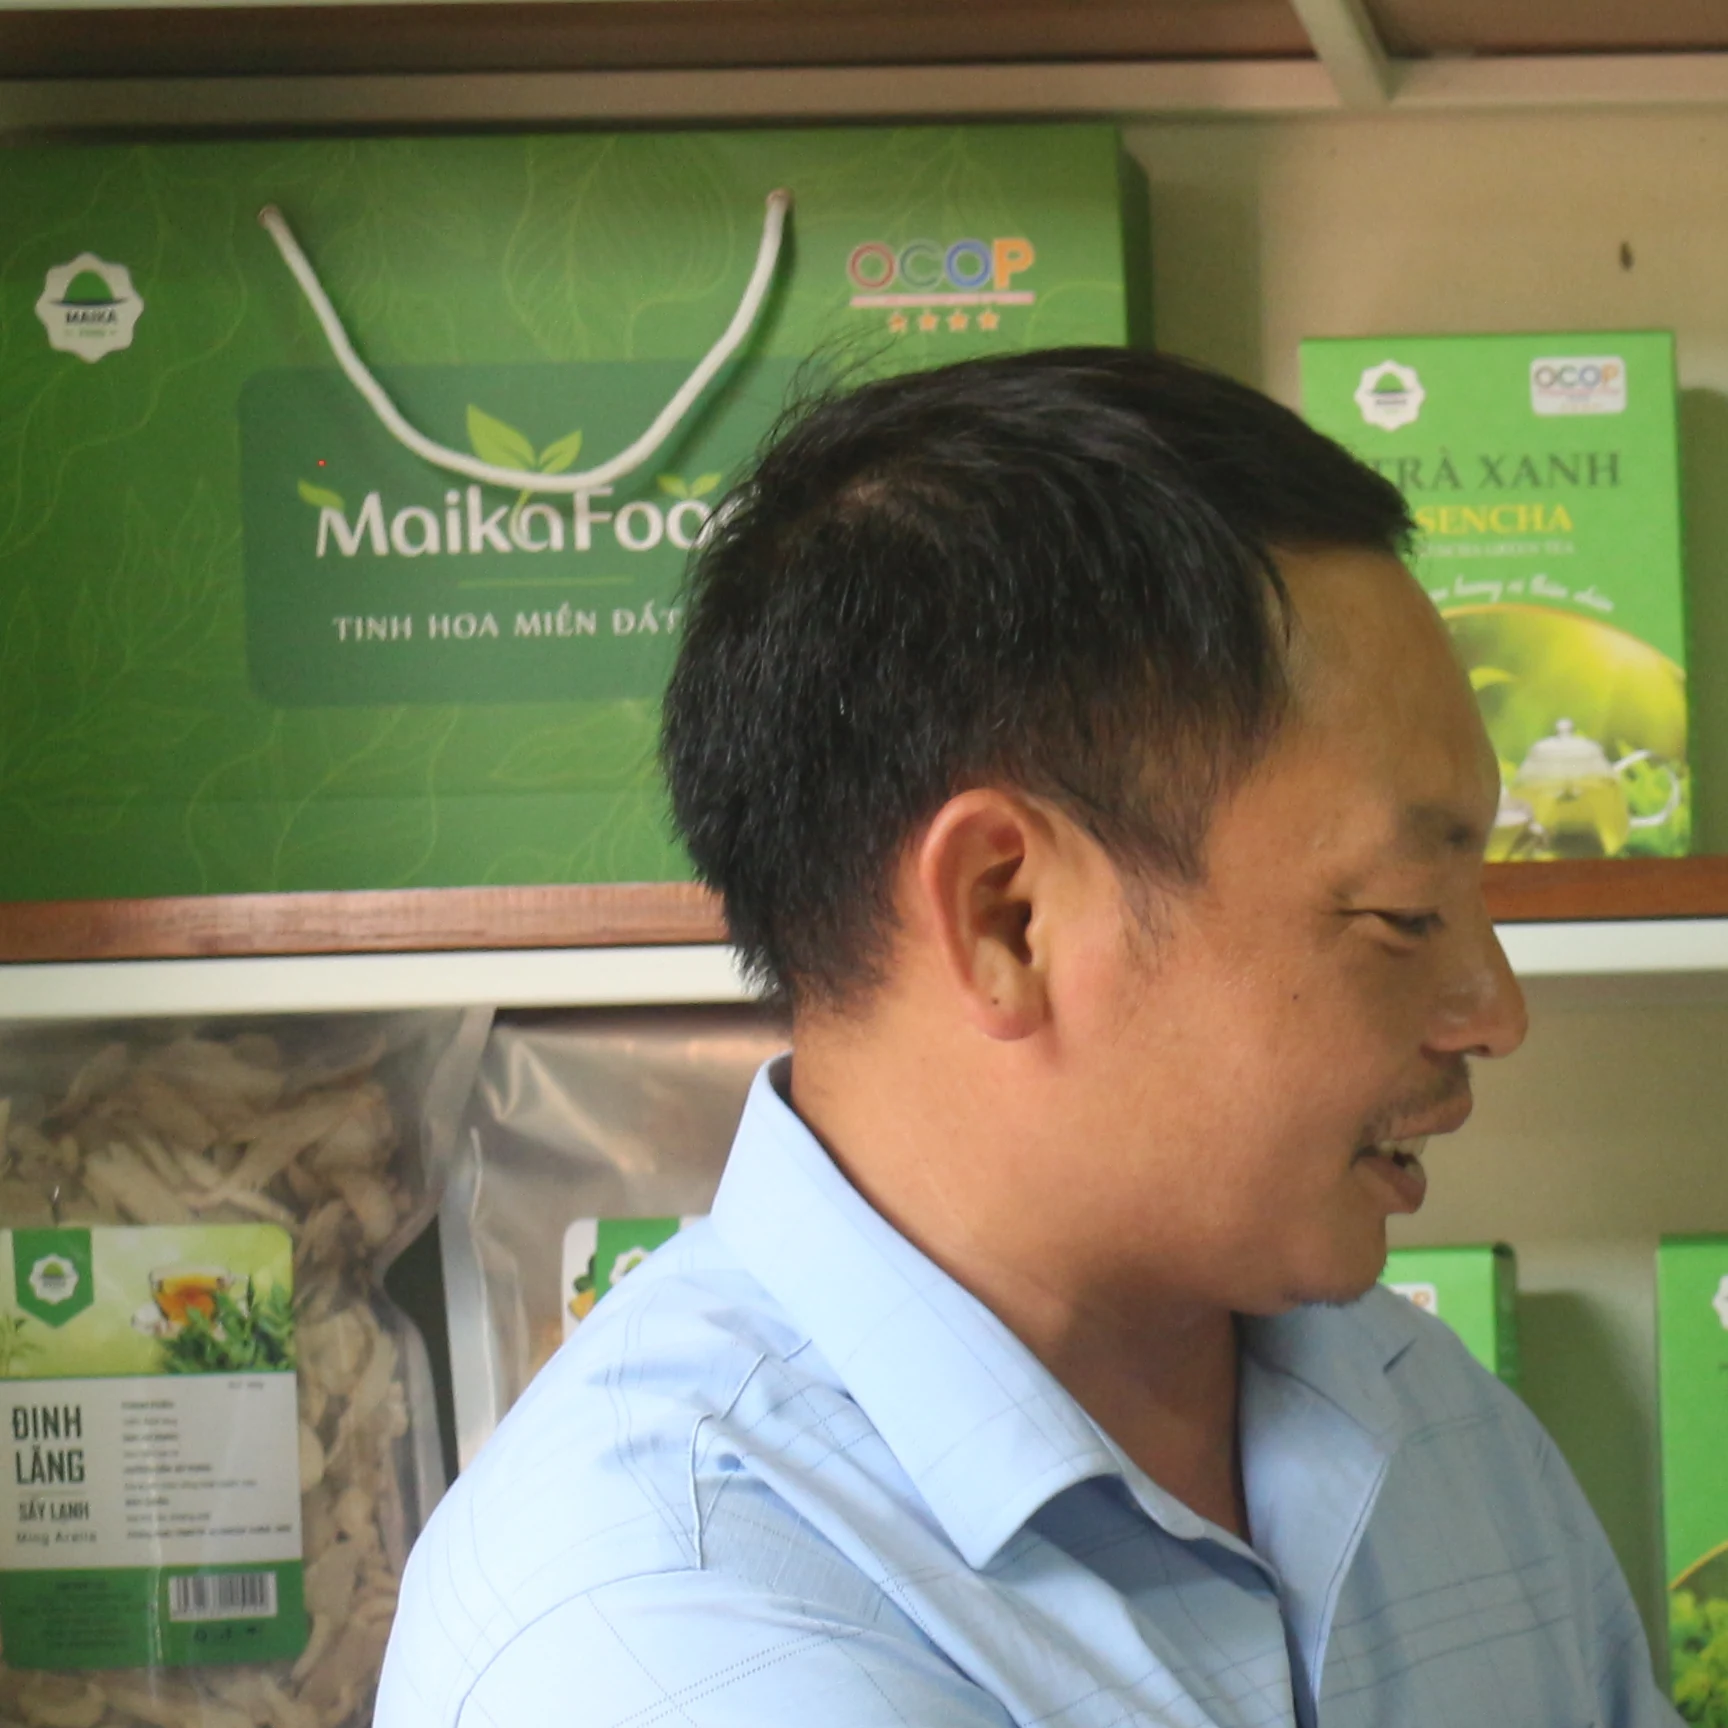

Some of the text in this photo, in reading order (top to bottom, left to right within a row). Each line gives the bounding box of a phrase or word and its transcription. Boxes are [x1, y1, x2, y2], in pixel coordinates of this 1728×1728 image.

[848, 237, 1034, 291] OCOP
[1534, 364, 1620, 389] OCOP
[1479, 450, 1623, 490] XANH
[1415, 503, 1573, 535] SENCHA
[332, 612, 413, 643] TINH
[428, 611, 500, 640] HOA
[12, 1404, 82, 1441] ĐINH
[15, 1445, 86, 1485] LĂNG
